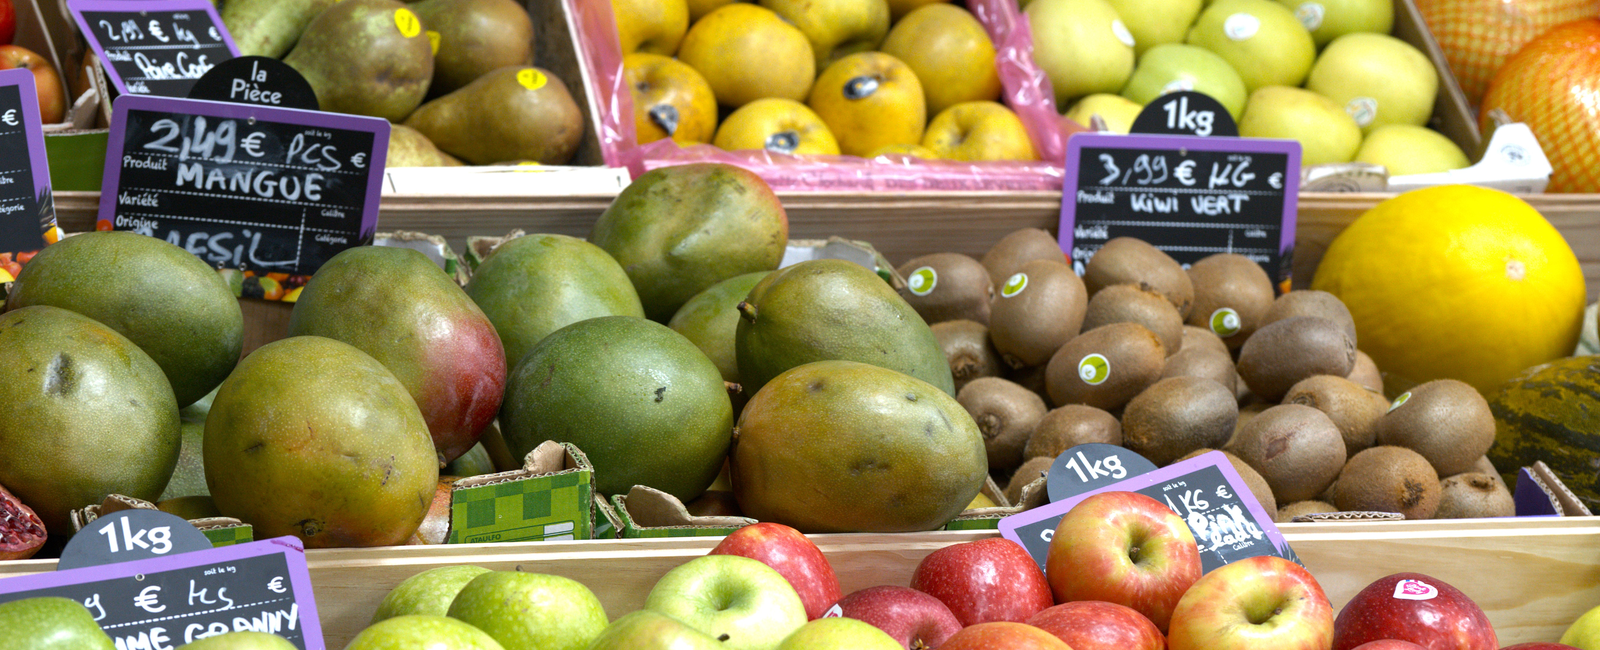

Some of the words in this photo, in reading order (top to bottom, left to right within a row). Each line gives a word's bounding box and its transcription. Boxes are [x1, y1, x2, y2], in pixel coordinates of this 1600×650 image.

[148, 19, 170, 43] €
[208, 26, 222, 41] €
[251, 61, 267, 82] la
[230, 78, 282, 105] Pièce
[1, 109, 20, 126] €
[1163, 96, 1215, 137] 1kg
[143, 116, 237, 164] 2,49
[241, 132, 266, 157] €
[350, 152, 367, 168] €
[123, 156, 168, 171] Produit
[1098, 153, 1169, 186] 3,99
[1173, 159, 1197, 186] €
[1267, 172, 1283, 189] €
[176, 162, 324, 200] MANGUE
[118, 193, 159, 208] Variété
[1077, 190, 1115, 204] Produit
[1190, 194, 1250, 216] VERT
[116, 214, 159, 230] Origine
[1065, 451, 1127, 482] 1kg
[1215, 484, 1233, 499] €
[99, 516, 173, 554] 1kg
[470, 533, 502, 543] ATAULFO
[1232, 540, 1255, 551] Calibre
[203, 567, 217, 576] soit
[226, 565, 237, 573] kg
[134, 585, 167, 613] €
[267, 576, 287, 593] €
